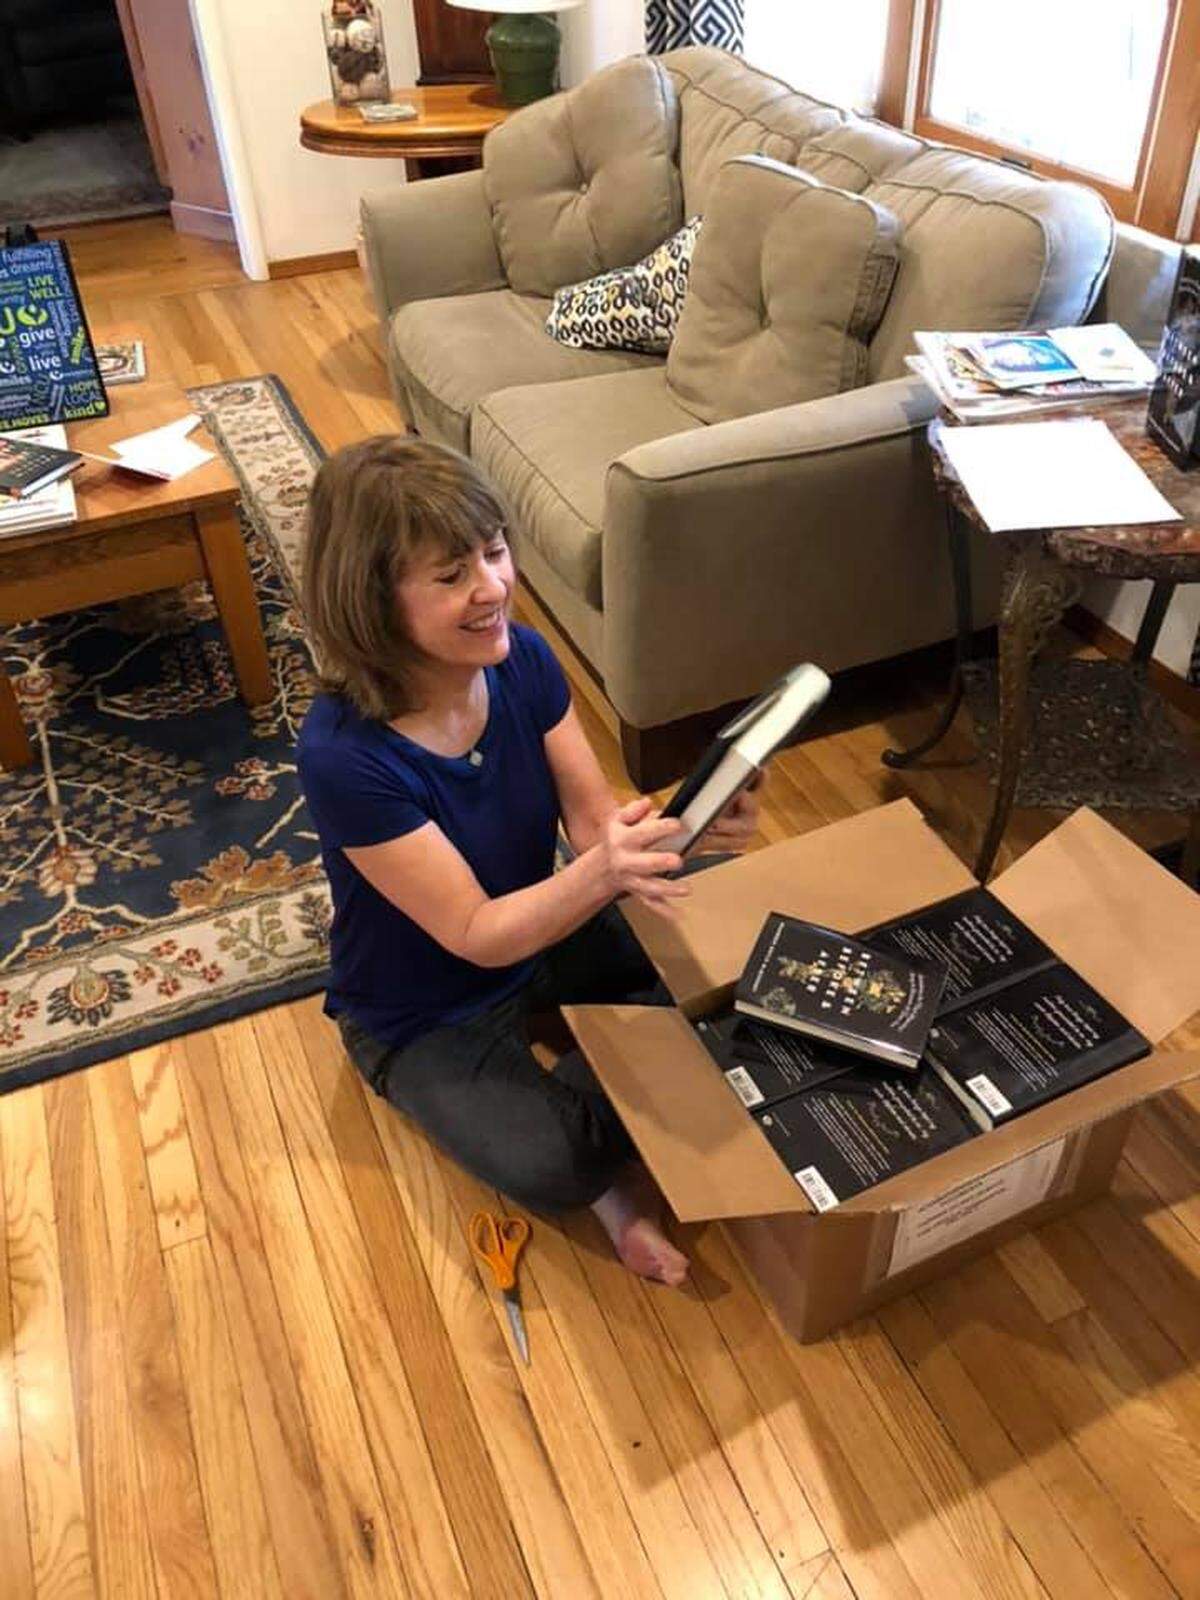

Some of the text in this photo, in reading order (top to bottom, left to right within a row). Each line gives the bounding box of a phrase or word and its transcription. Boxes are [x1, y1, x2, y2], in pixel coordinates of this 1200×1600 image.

[28, 274, 54, 288] LIVE
[29, 286, 63, 300] WELL
[19, 327, 56, 349] give
[28, 355, 61, 372] live
[63, 402, 95, 419] kind
